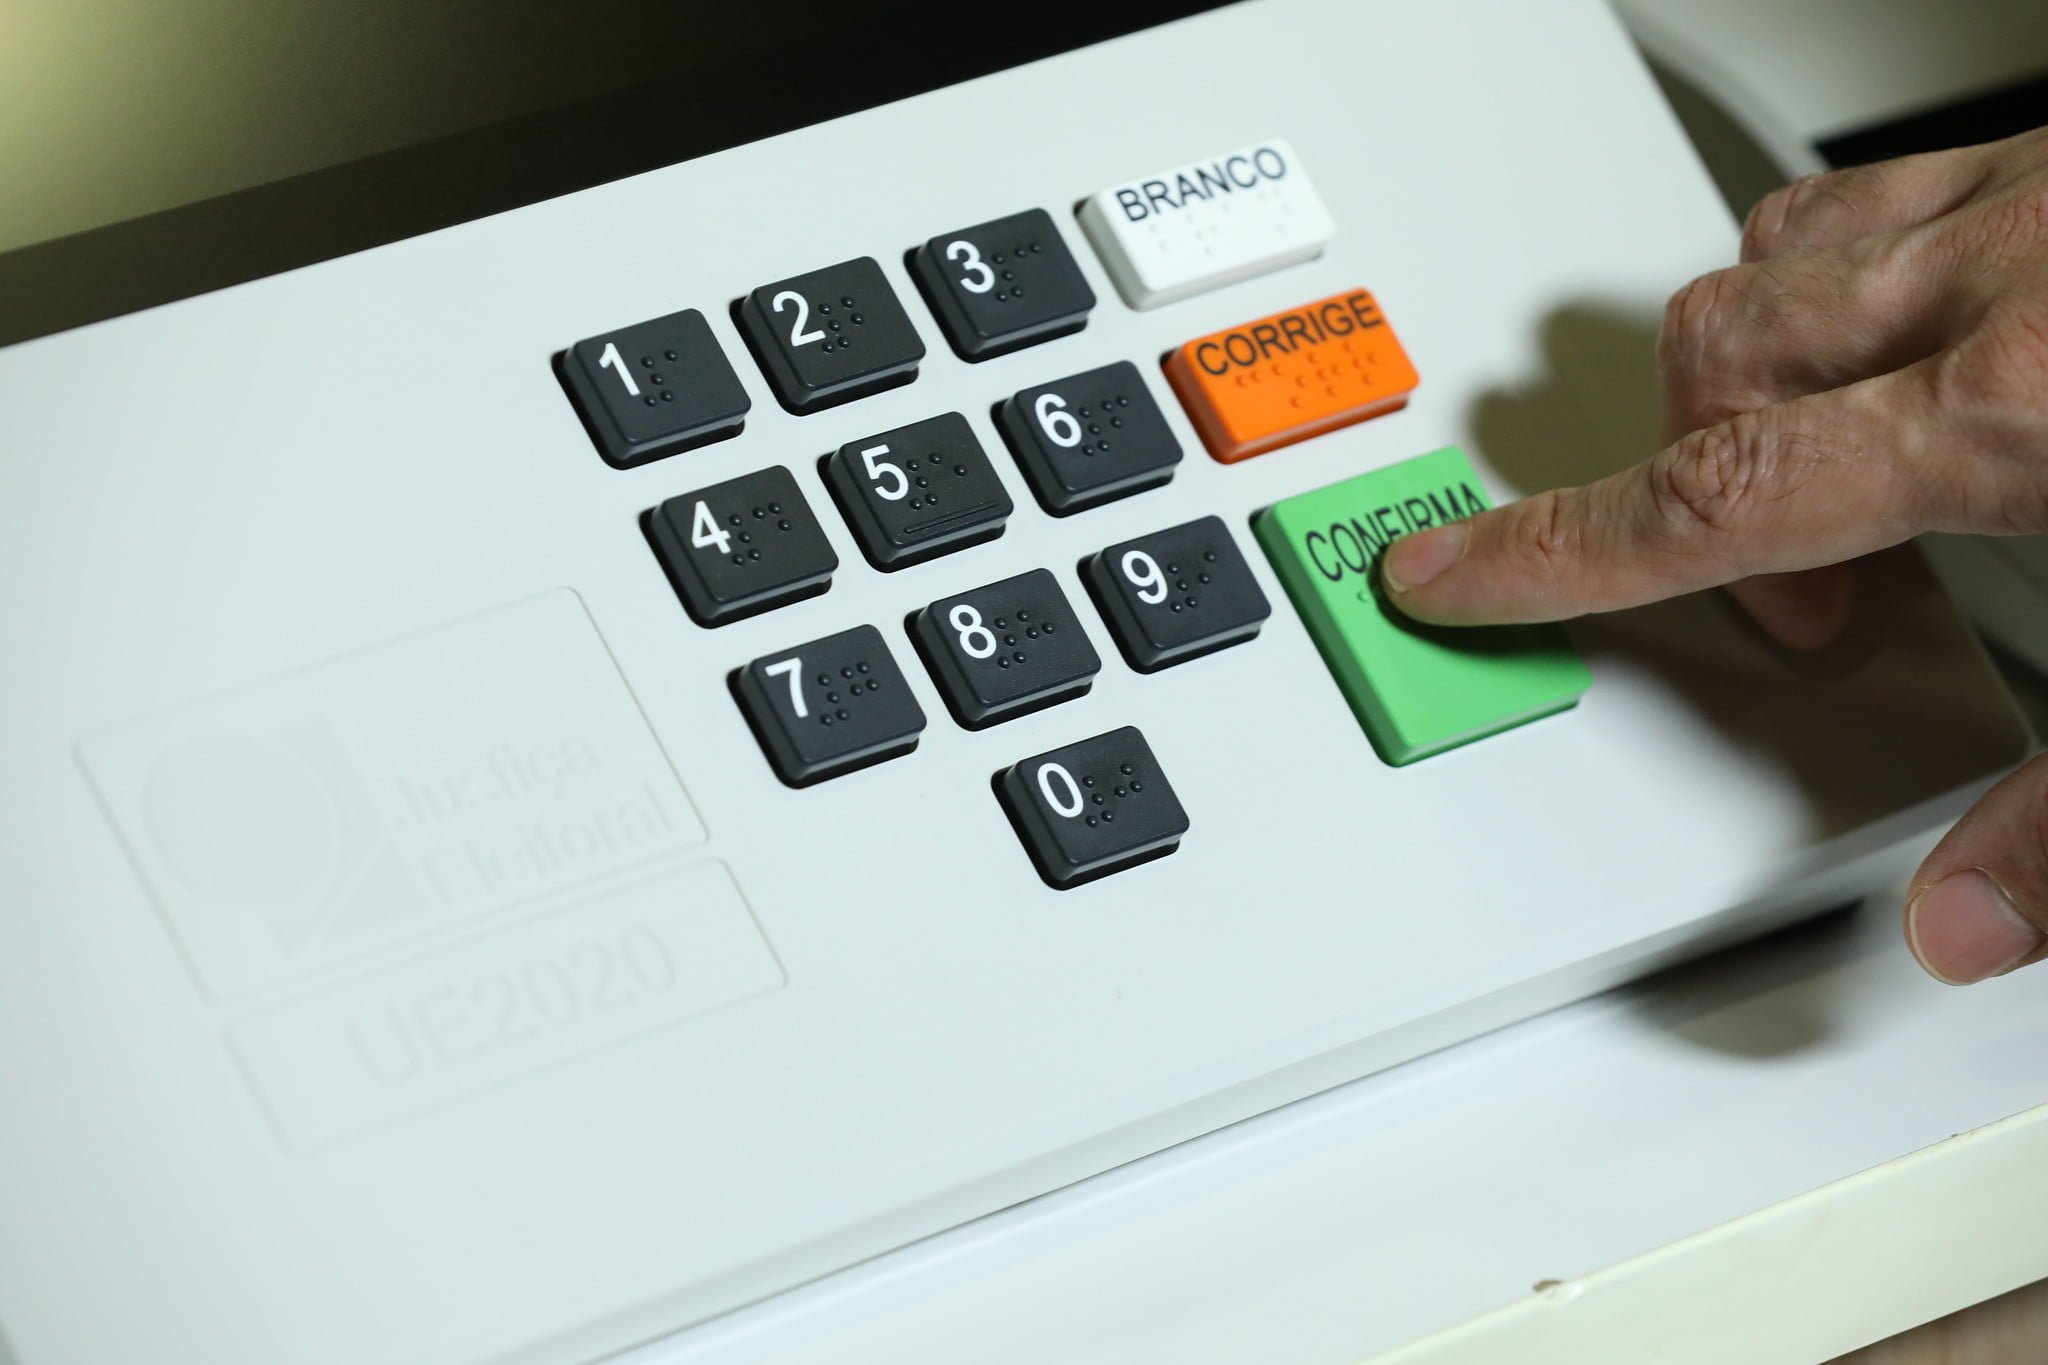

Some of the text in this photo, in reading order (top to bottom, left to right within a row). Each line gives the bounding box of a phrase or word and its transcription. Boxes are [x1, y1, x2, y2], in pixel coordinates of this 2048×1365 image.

[1115, 147, 1287, 222] BRANCO
[946, 240, 996, 294] 3
[773, 290, 826, 347] 2
[1196, 293, 1382, 375] CORRIGE
[598, 342, 641, 396] 1
[1034, 393, 1082, 448] 6
[860, 444, 909, 501] 5
[691, 500, 732, 554] 4
[1121, 550, 1169, 605] 9
[948, 604, 997, 660] 8
[765, 657, 809, 718] 7
[1036, 762, 1084, 818] 0
[342, 923, 677, 1088] UE2020
